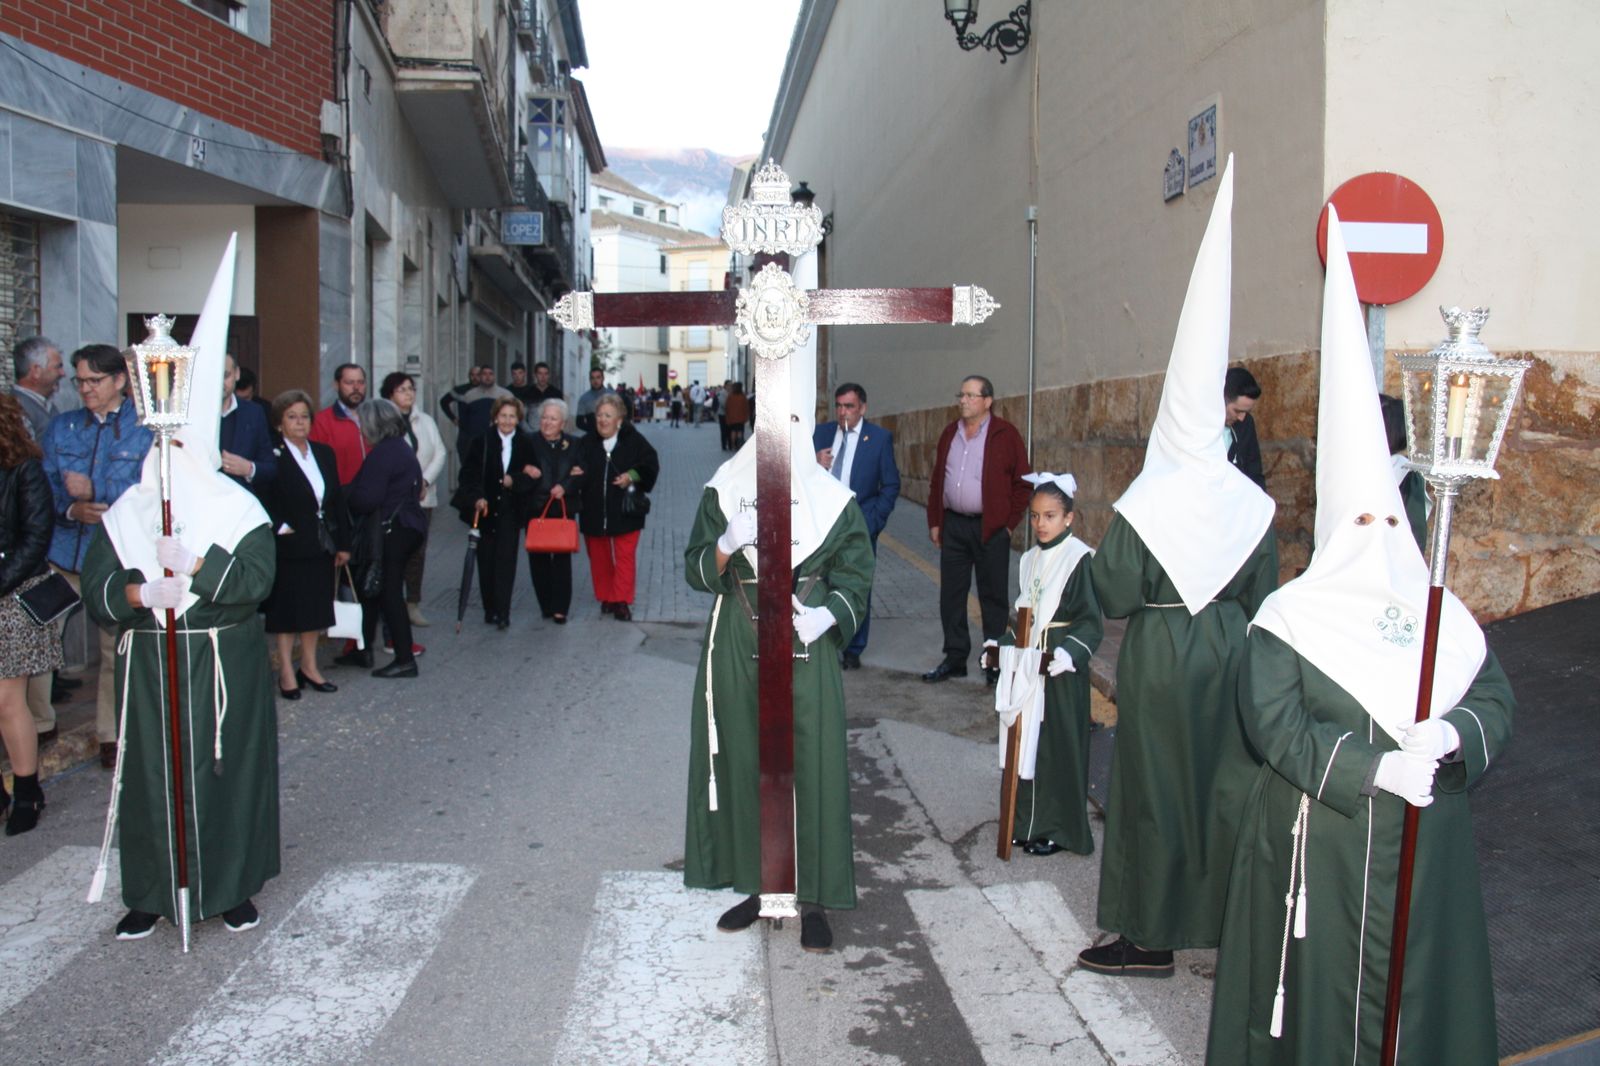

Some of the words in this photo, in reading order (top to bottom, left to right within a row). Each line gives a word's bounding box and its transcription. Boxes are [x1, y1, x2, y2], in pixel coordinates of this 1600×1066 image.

[193, 138, 206, 160] 24
[504, 223, 540, 236] LOPEZ
[741, 216, 802, 243] INRI
